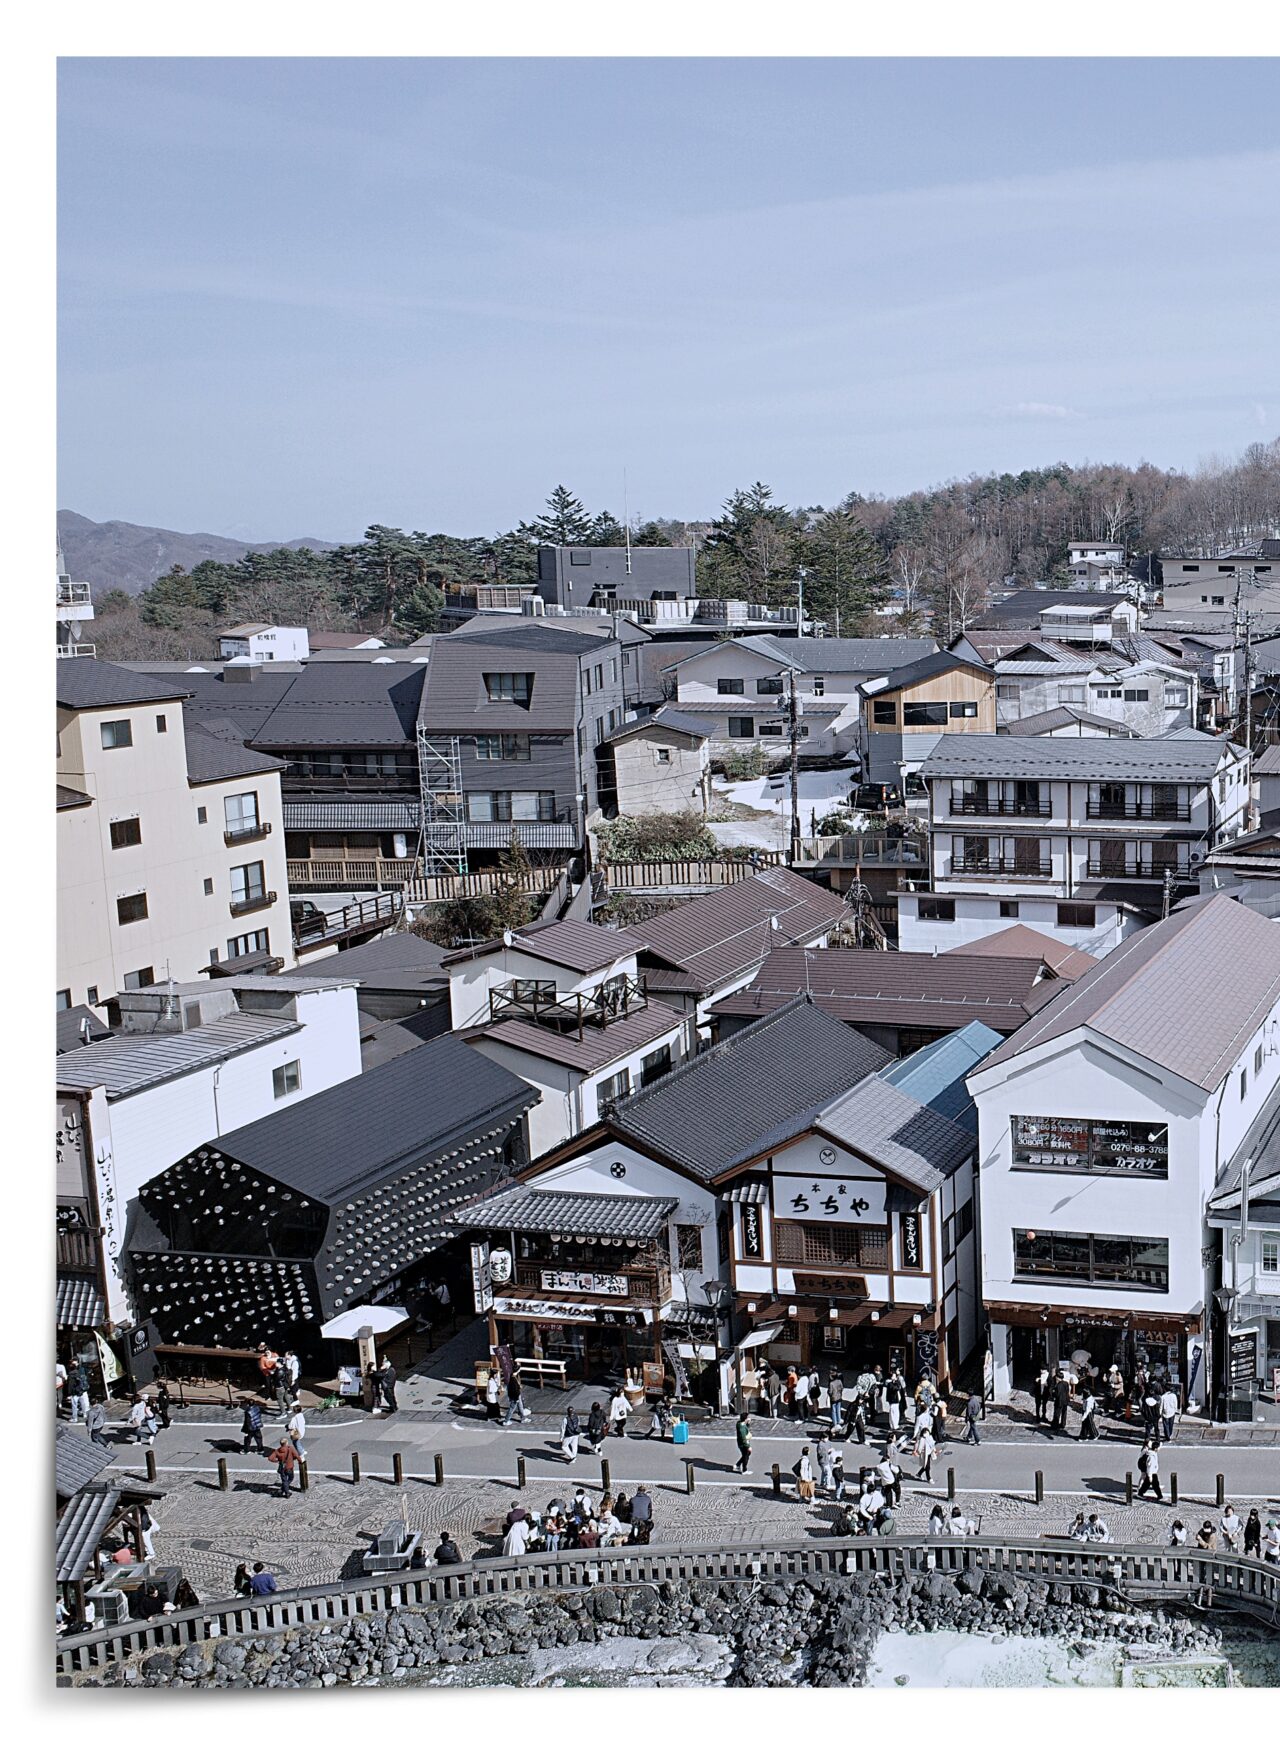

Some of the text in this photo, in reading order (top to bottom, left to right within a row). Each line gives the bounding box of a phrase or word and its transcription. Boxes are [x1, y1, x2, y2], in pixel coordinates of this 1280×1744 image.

[1116, 1156, 1157, 1169] カラオケ
[811, 1183, 848, 1195] 本家
[790, 1194, 870, 1217] ちちや
